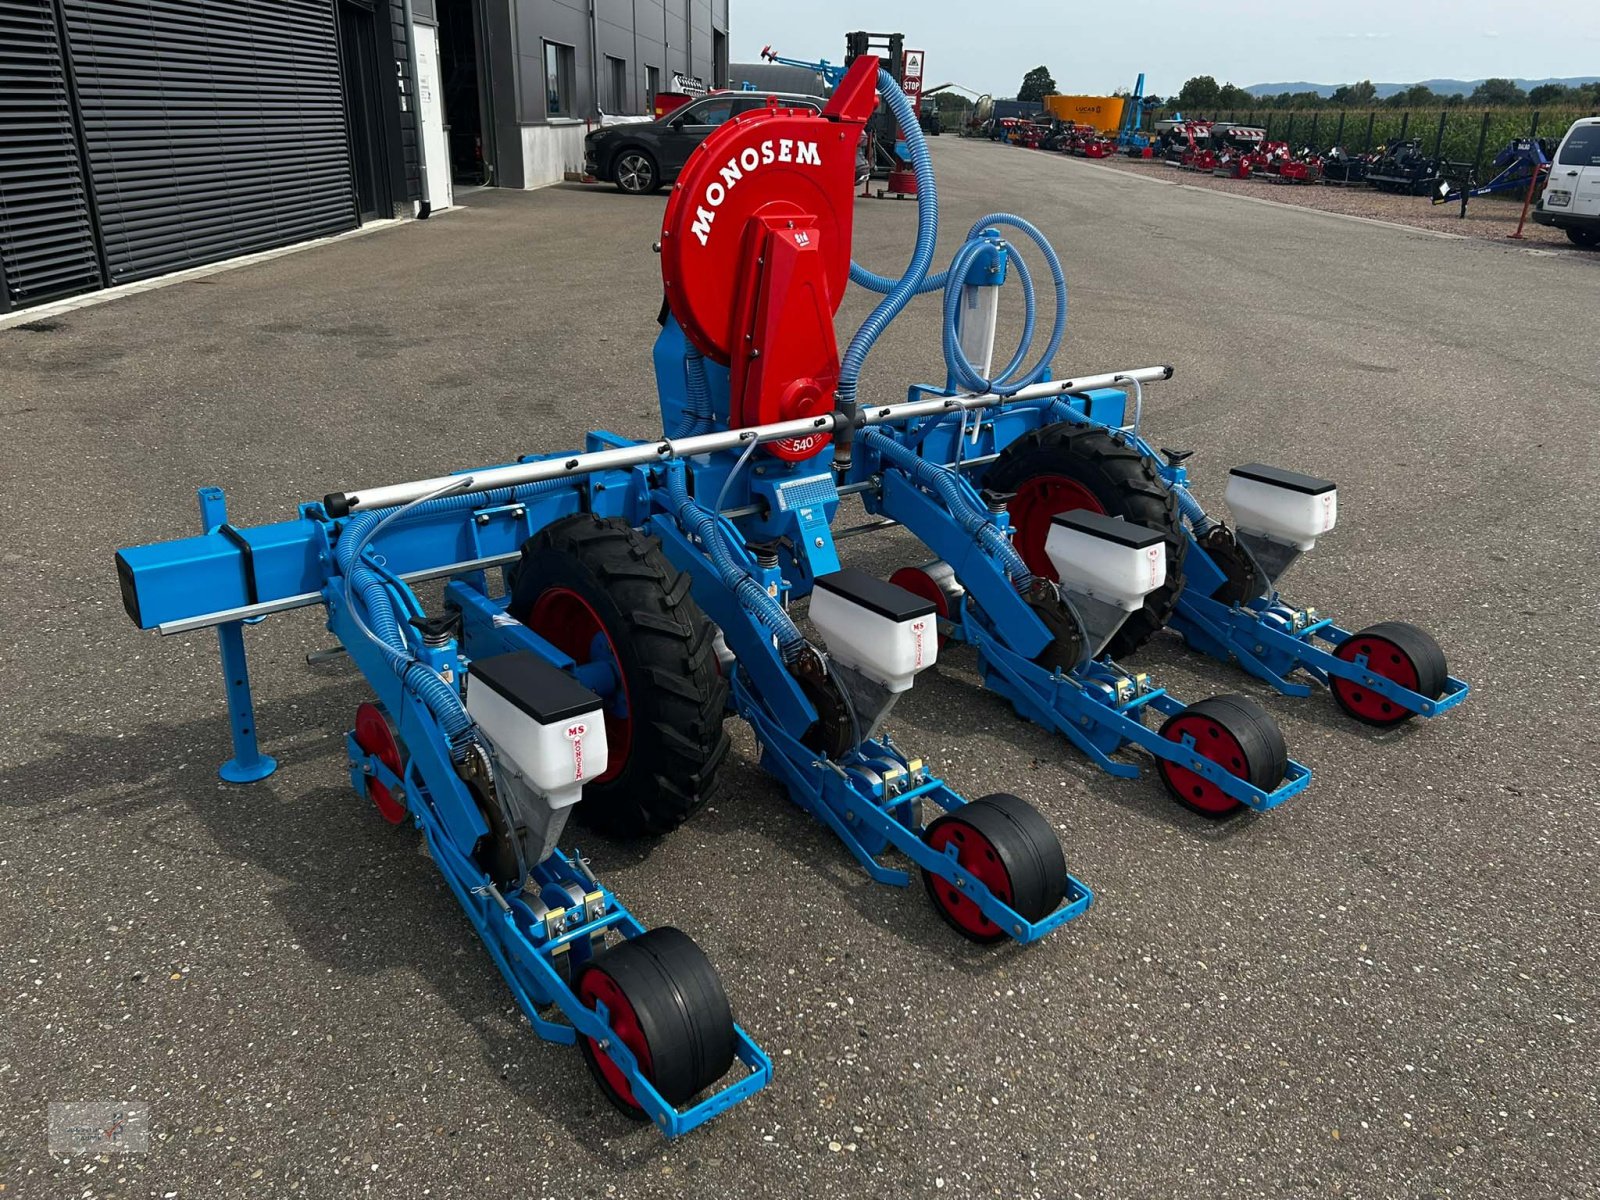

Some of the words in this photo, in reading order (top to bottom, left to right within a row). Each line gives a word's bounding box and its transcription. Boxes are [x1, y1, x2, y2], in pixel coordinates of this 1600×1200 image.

[904, 81, 920, 90] STOP
[1075, 105, 1096, 113] LUCAS
[691, 138, 822, 247] MONOSEM
[792, 436, 814, 452] 540
[913, 622, 924, 631] MS
[568, 725, 585, 737] MS
